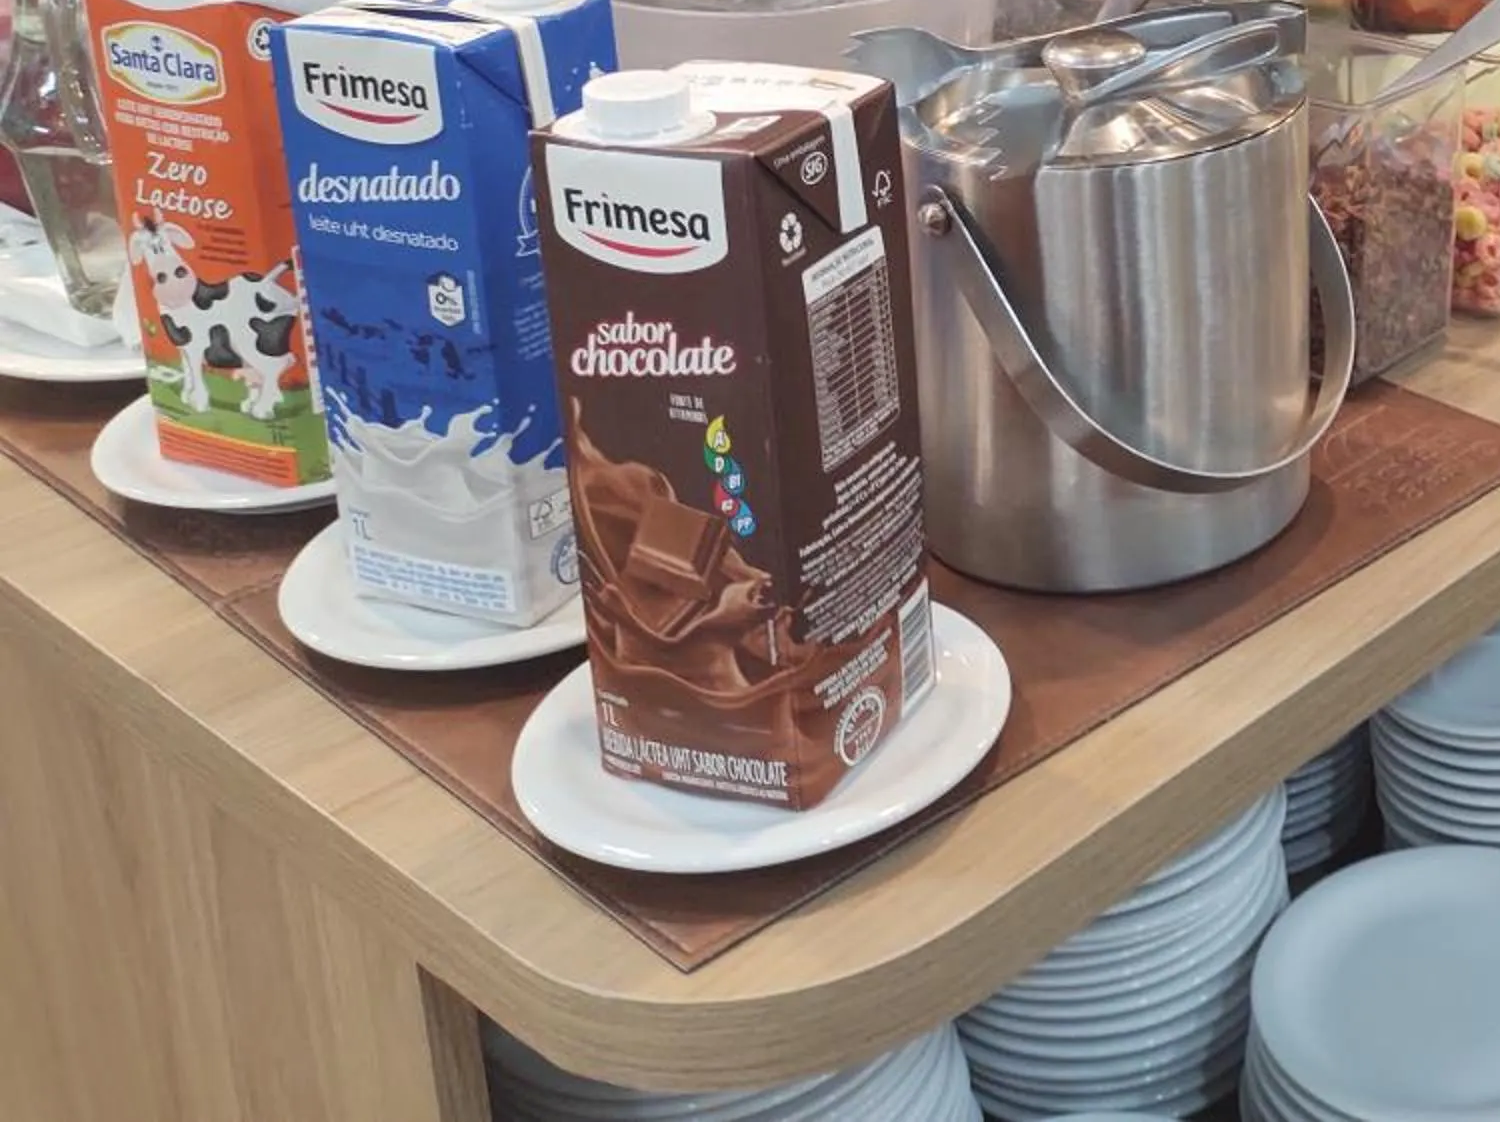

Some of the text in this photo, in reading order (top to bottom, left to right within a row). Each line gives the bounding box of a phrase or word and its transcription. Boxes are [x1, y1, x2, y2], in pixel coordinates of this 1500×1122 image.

[110, 42, 217, 84] Santa Clara
[302, 61, 429, 112] Frimesa
[148, 150, 208, 186] Zero
[299, 159, 462, 204] desnatado
[135, 179, 233, 221] Lactose
[563, 187, 711, 242] Frimesa
[371, 223, 459, 252] desnatado
[597, 311, 674, 346] sabor
[570, 334, 738, 378] chocolate
[715, 456, 725, 474] D
[727, 756, 788, 787] CHOCOLATE
